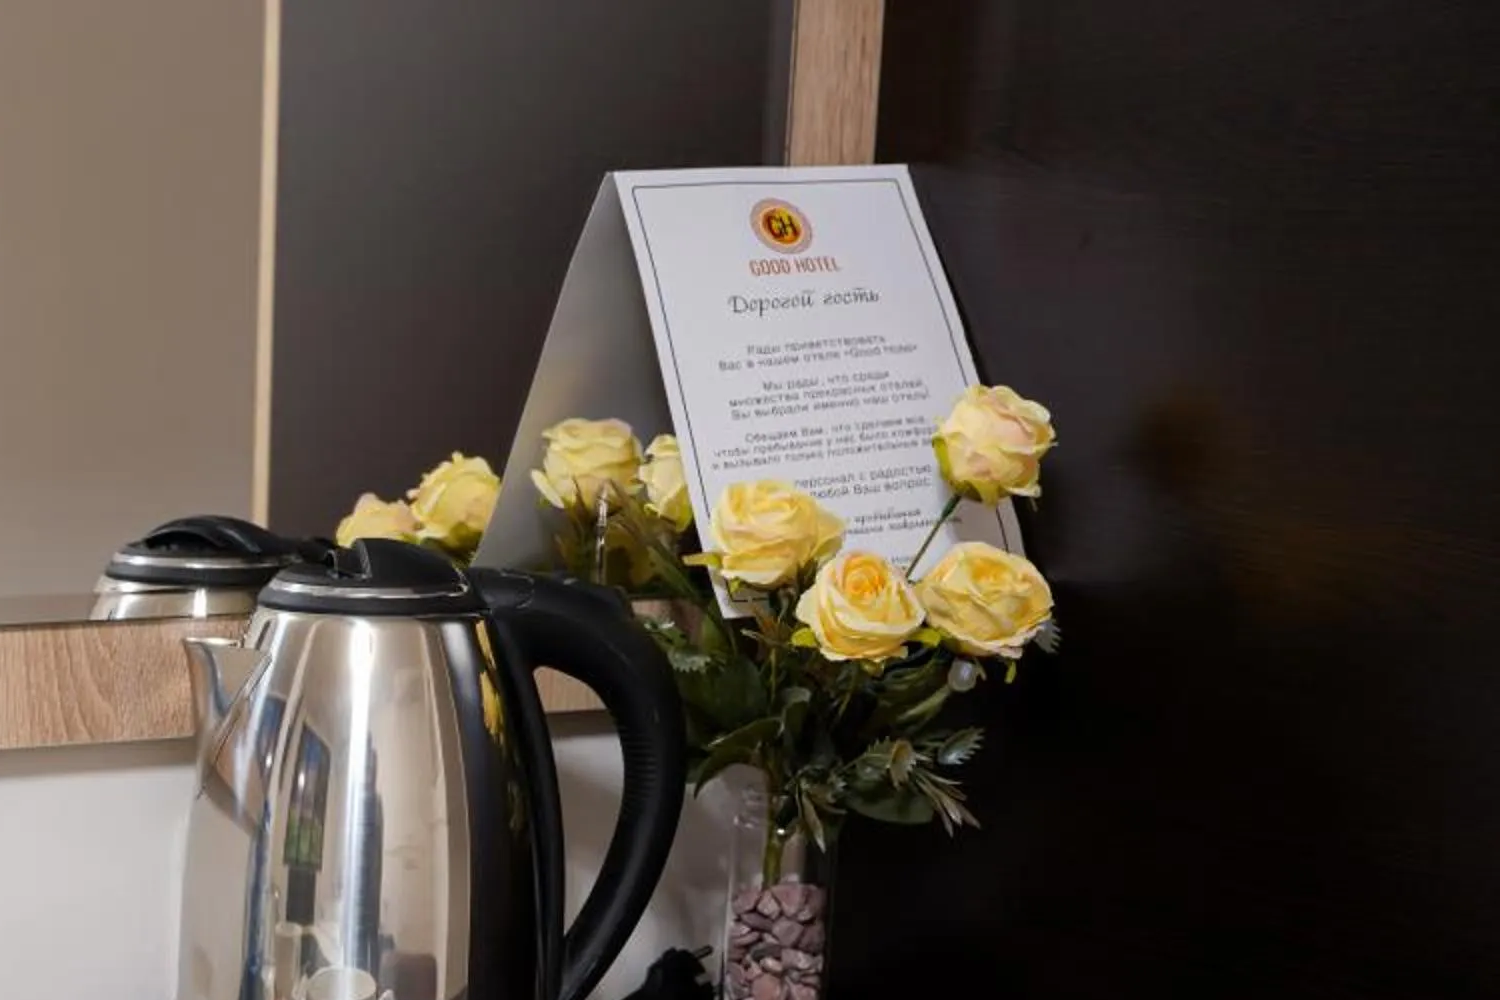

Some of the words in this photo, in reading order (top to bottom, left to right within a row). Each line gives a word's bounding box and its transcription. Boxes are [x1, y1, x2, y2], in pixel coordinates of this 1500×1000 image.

[749, 258, 791, 277] GOOD
[794, 255, 842, 273] HOTEL
[728, 289, 816, 317] Дорогой
[823, 287, 880, 305] гость
